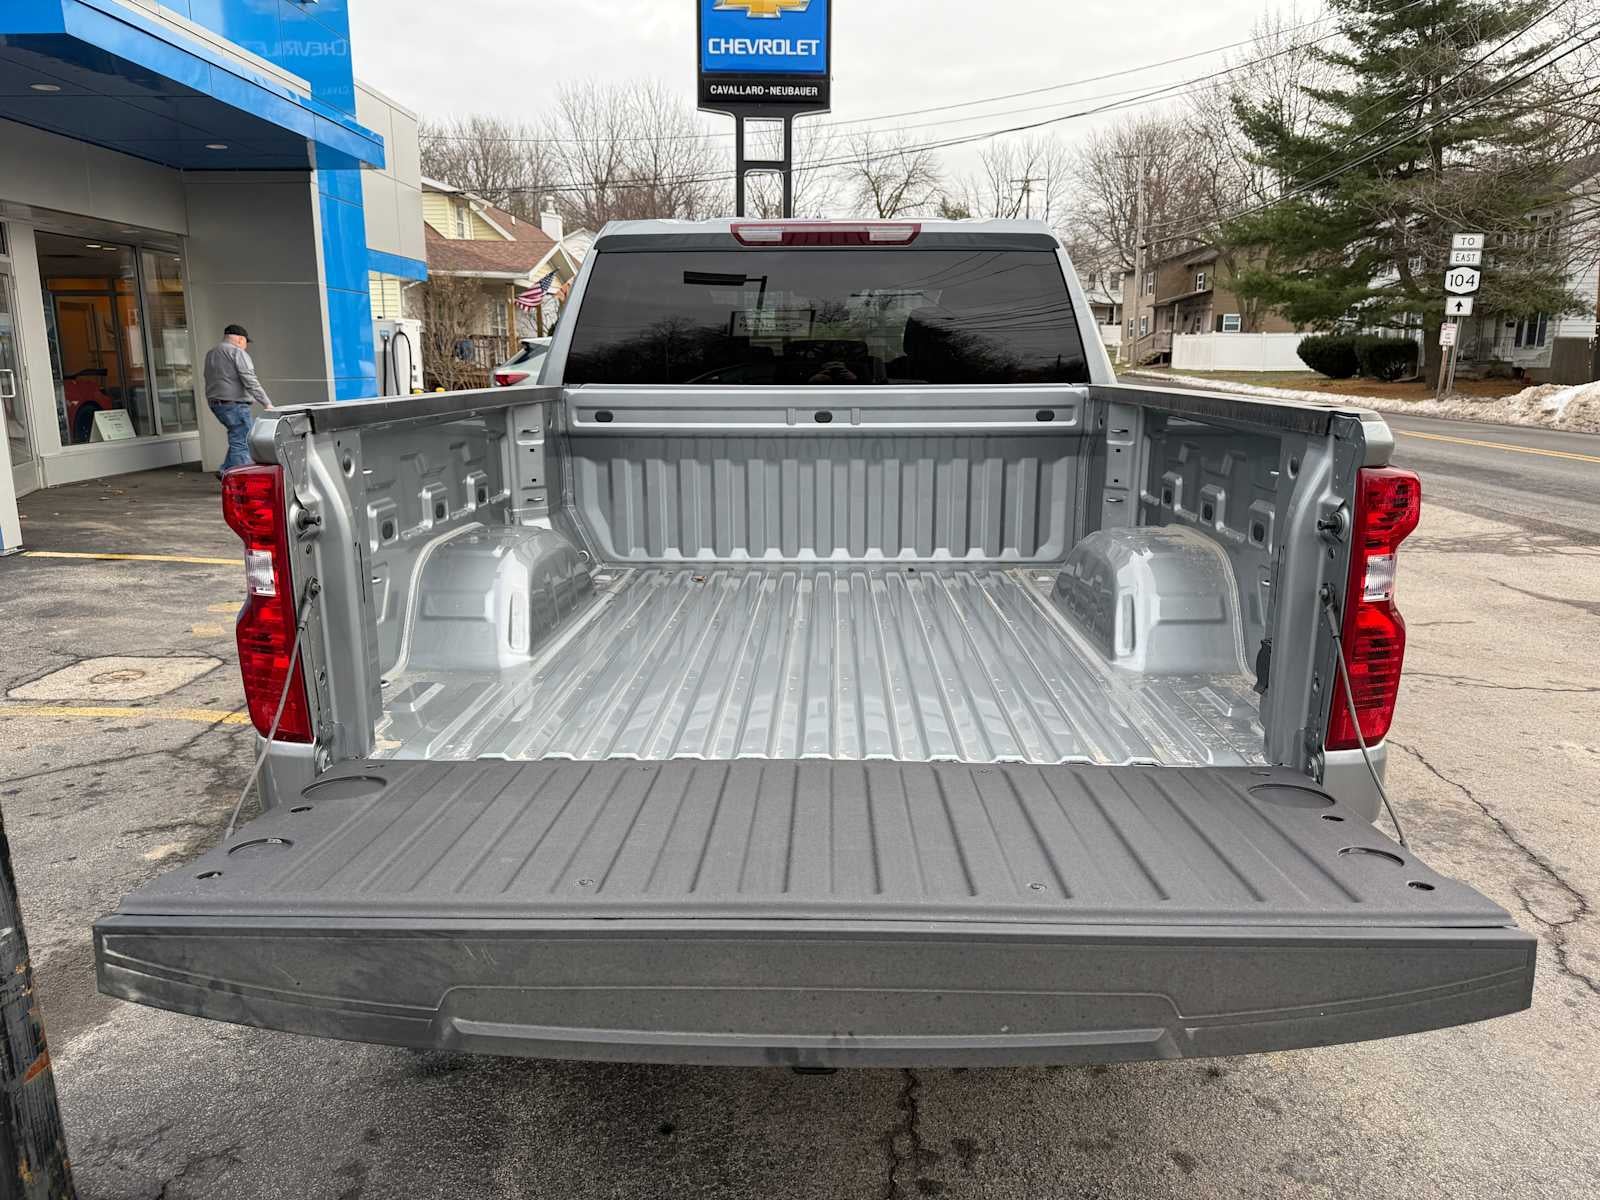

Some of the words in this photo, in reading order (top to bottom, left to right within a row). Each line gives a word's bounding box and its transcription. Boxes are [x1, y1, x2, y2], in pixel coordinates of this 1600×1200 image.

[708, 38, 820, 56] CHEVROLET
[710, 85, 818, 96] CAVALLARO-NEUBAUER
[1461, 237, 1475, 246] TO
[1455, 253, 1476, 262] EAST
[1449, 274, 1475, 287] 104
